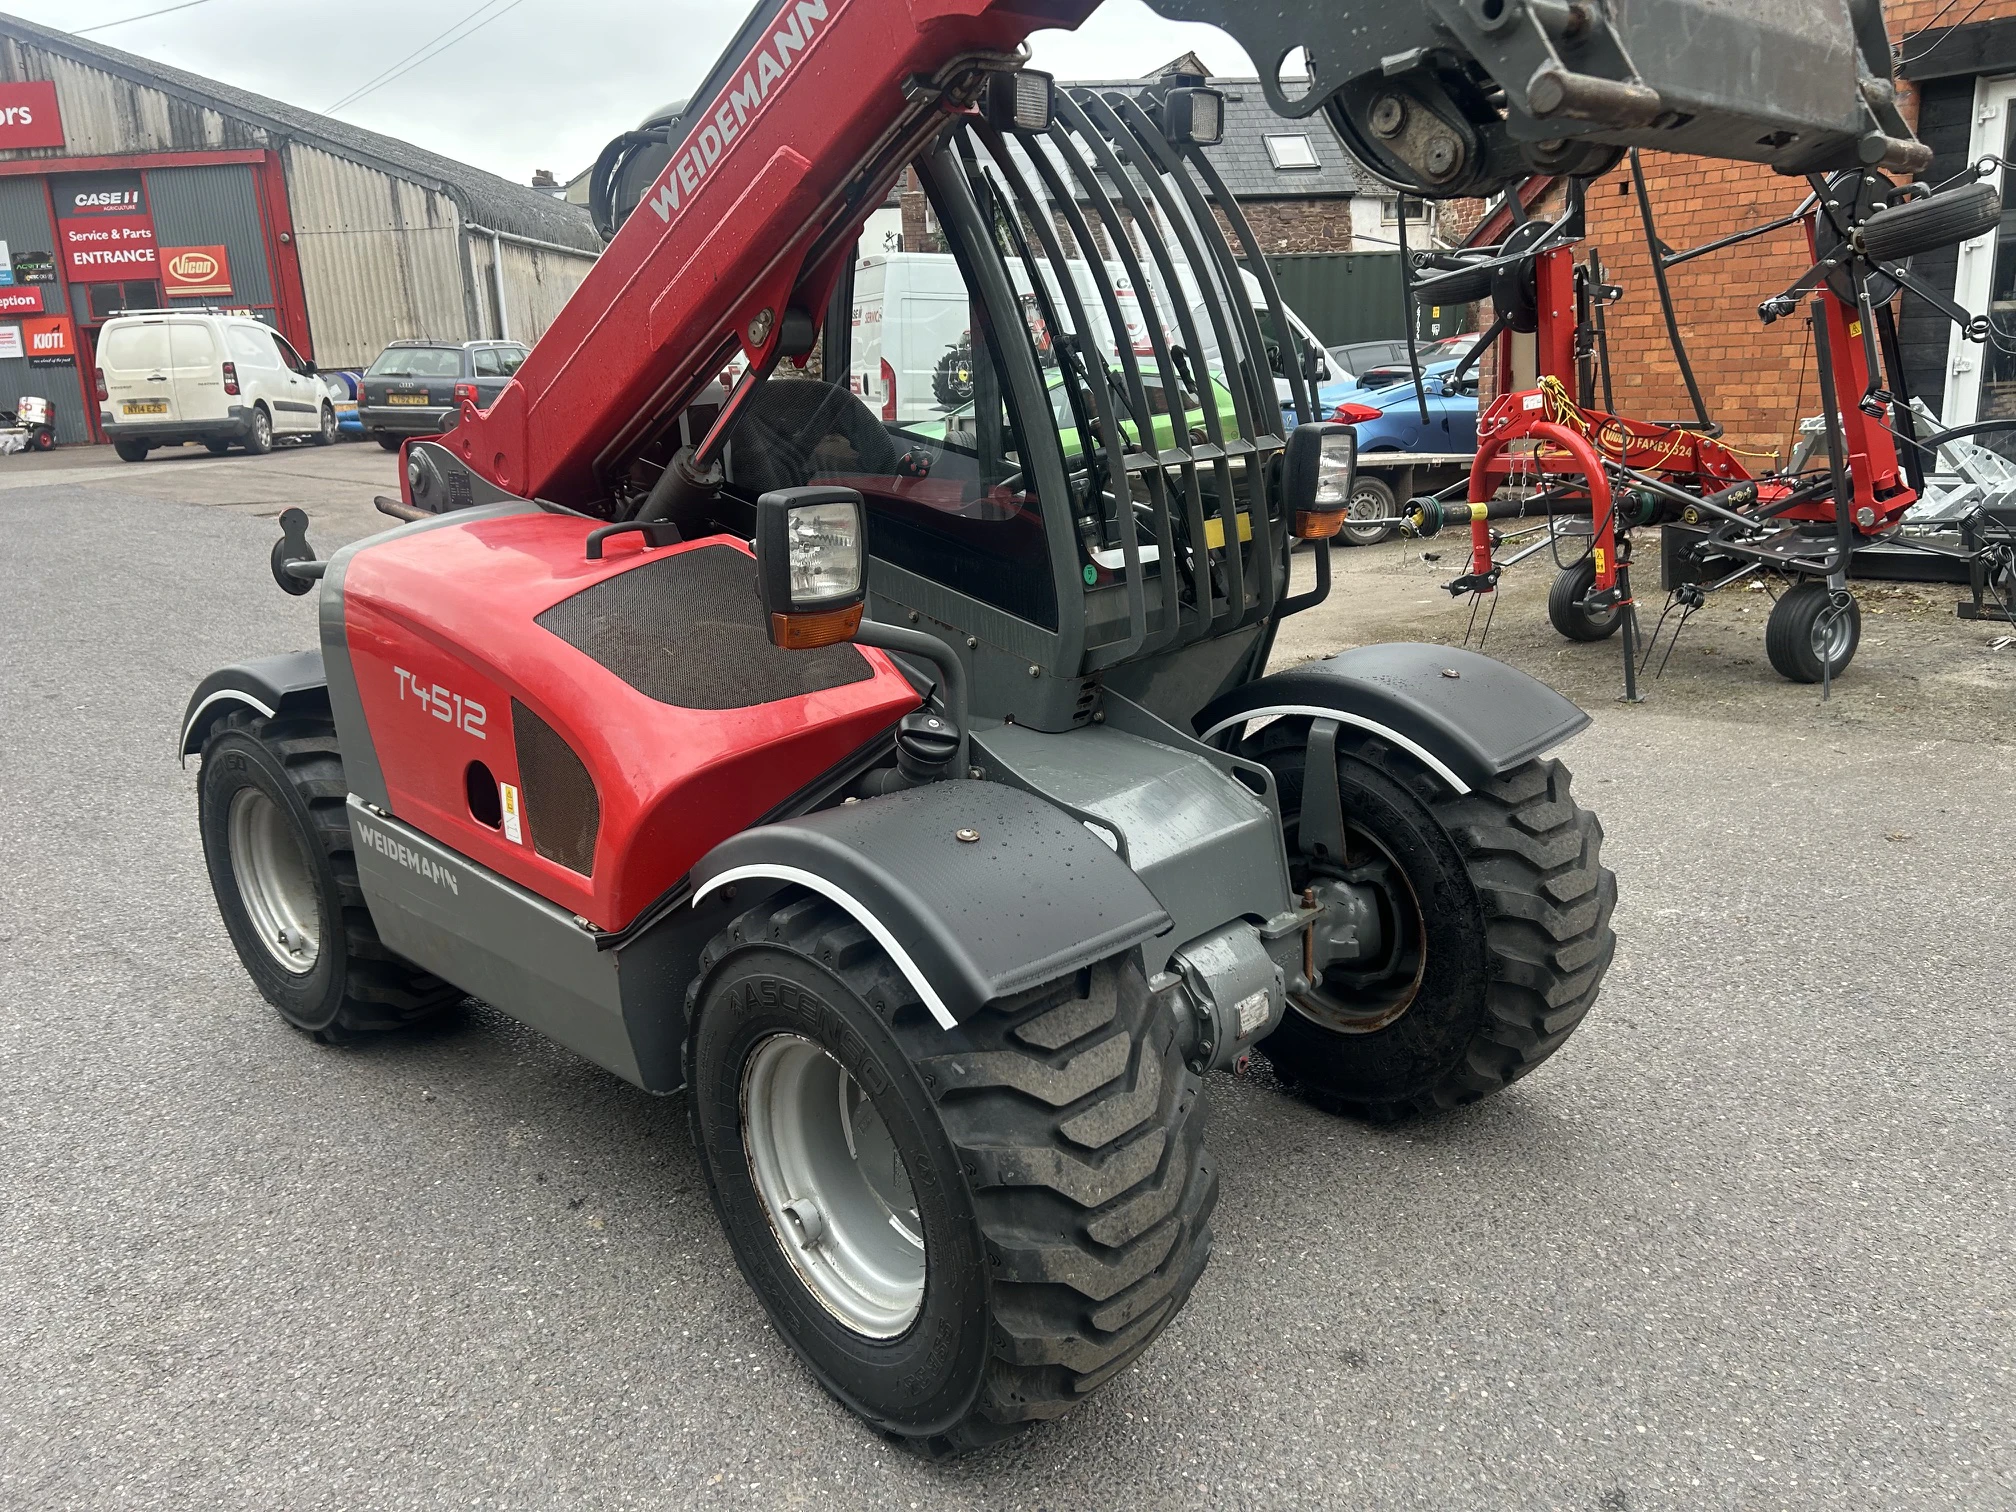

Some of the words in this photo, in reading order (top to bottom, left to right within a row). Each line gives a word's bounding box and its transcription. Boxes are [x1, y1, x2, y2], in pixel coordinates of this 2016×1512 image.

[649, 0, 829, 224] WEIDEMANN
[75, 191, 122, 206] CASE
[69, 230, 109, 242] Service
[111, 229, 120, 240] &
[123, 228, 152, 240] Parts
[73, 249, 156, 266] ENTRANCE
[33, 332, 64, 350] KIOTI
[1636, 437, 1671, 454] FANEX
[1672, 444, 1693, 458] 524
[393, 665, 487, 741] T4512
[356, 820, 459, 896] WEIDEMANN
[745, 979, 889, 1096] ASCENSO
